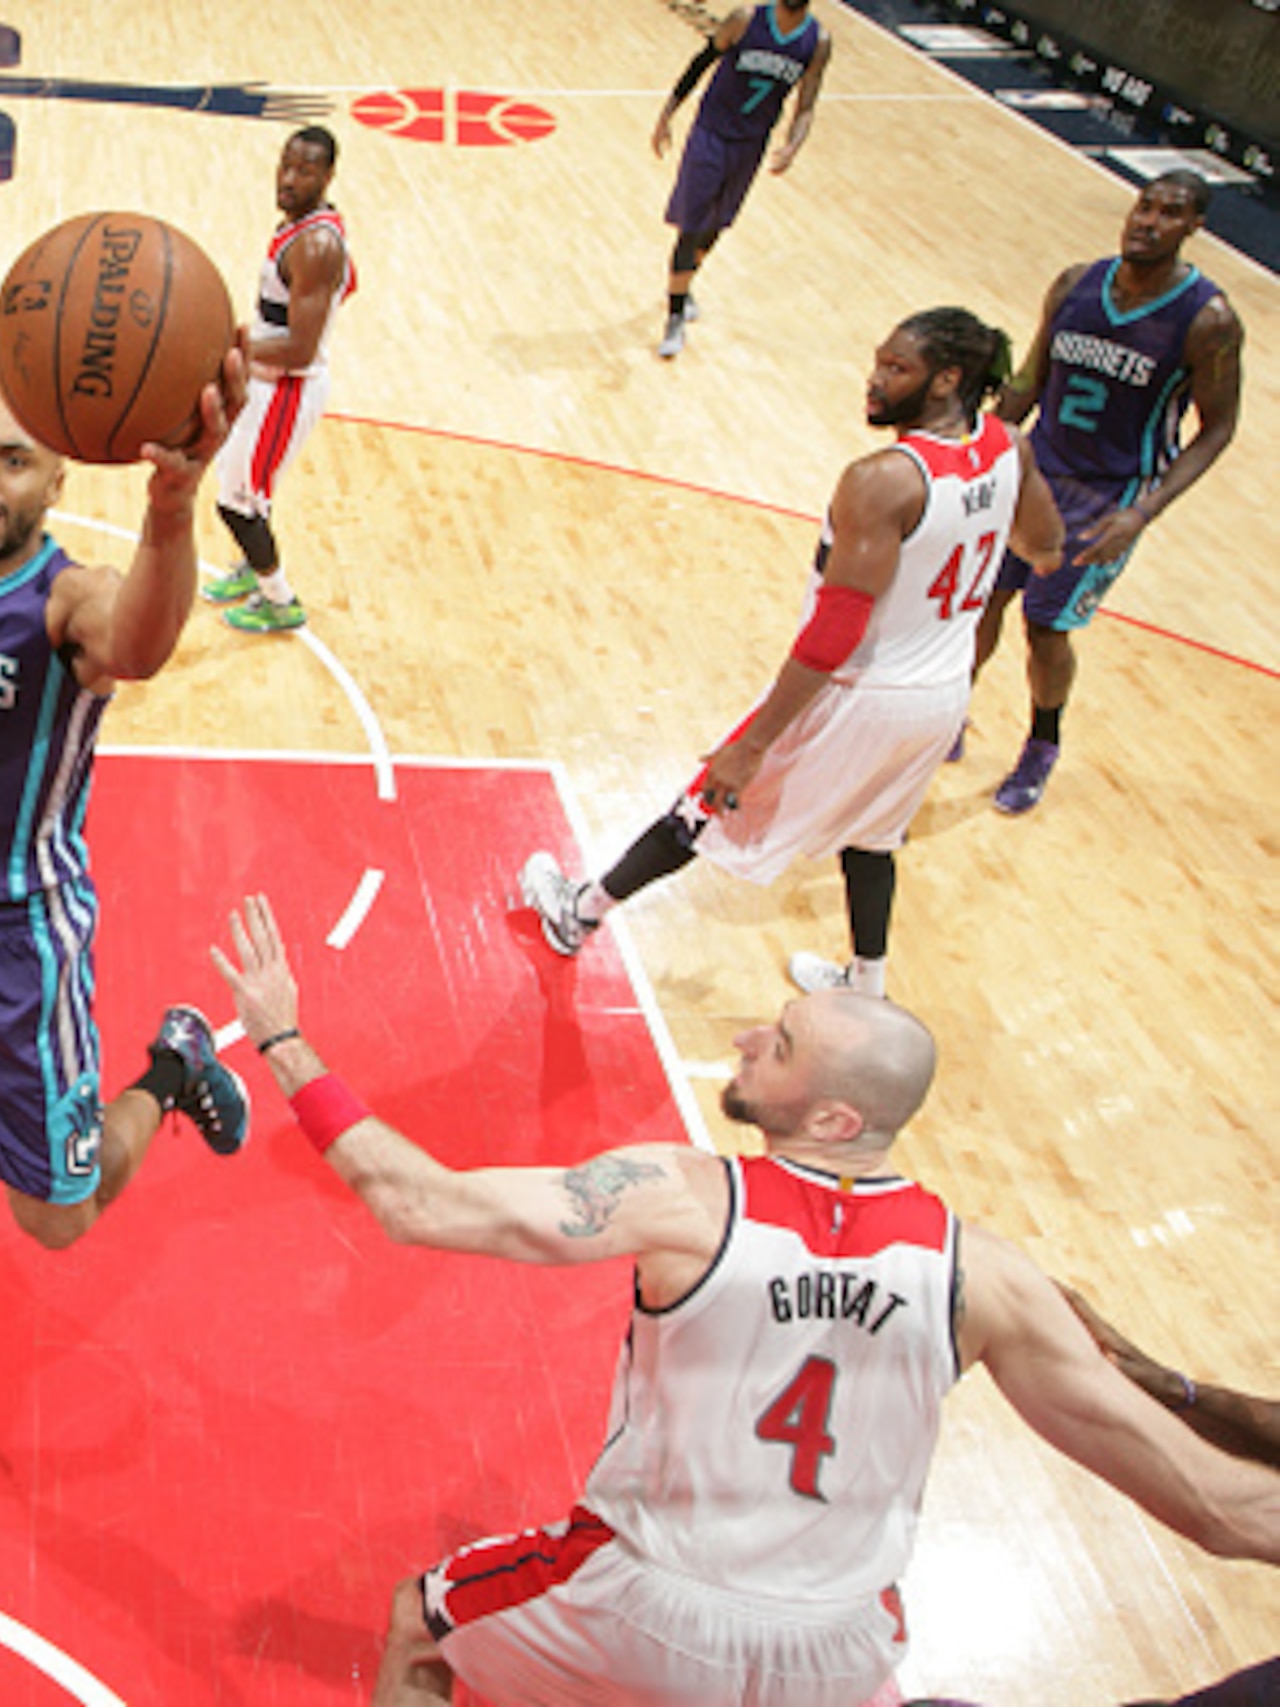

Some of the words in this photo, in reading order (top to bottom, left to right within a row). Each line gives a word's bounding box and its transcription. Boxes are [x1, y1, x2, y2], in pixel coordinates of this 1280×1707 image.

[741, 79, 773, 114] 7
[73, 224, 142, 398] SPALDING
[1050, 331, 1156, 387] HORNETS
[1059, 374, 1108, 432] 2
[927, 531, 996, 620] 42
[769, 1272, 908, 1336] GORTAT
[754, 1353, 837, 1504] 4
